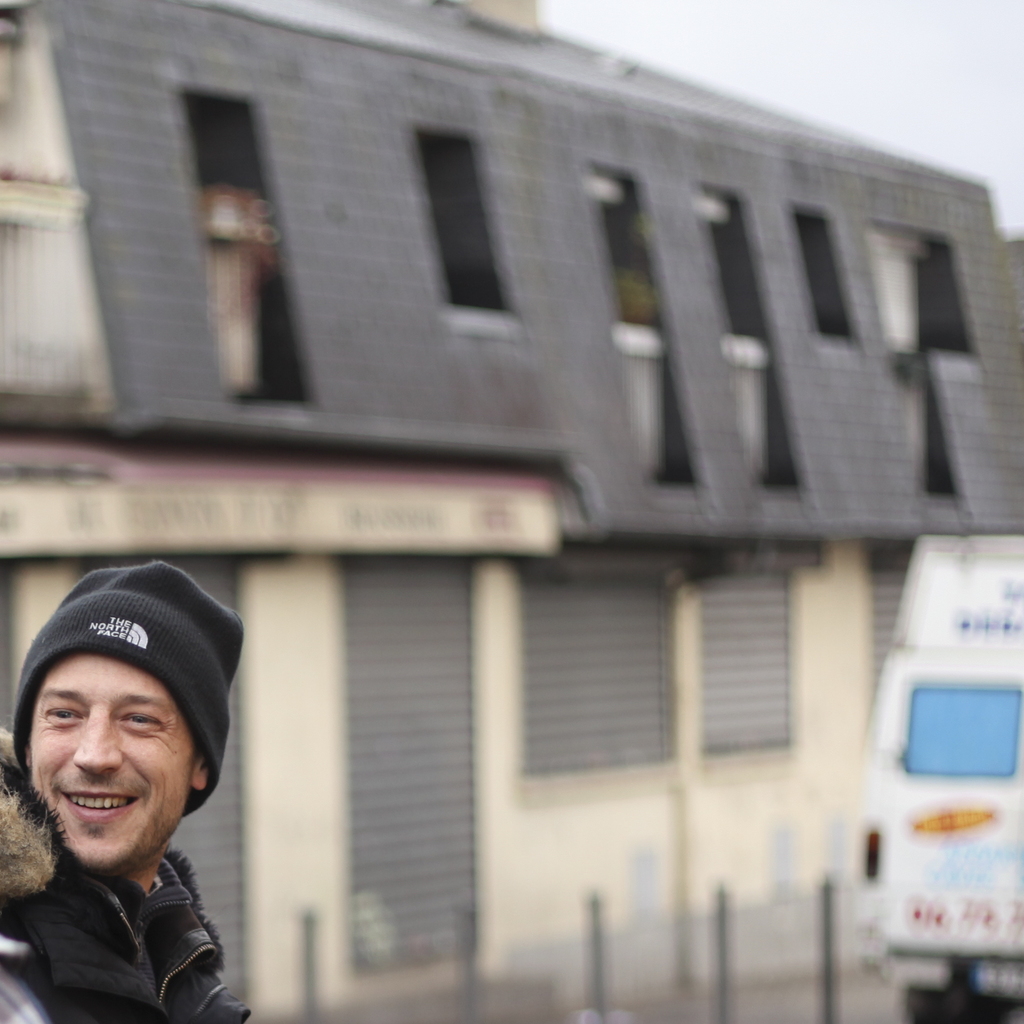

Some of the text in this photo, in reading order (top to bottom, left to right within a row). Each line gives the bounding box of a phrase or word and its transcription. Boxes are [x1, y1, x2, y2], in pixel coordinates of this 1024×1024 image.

[89, 622, 129, 634] NORTH
[109, 616, 132, 628] THE
[97, 629, 127, 640] FACE
